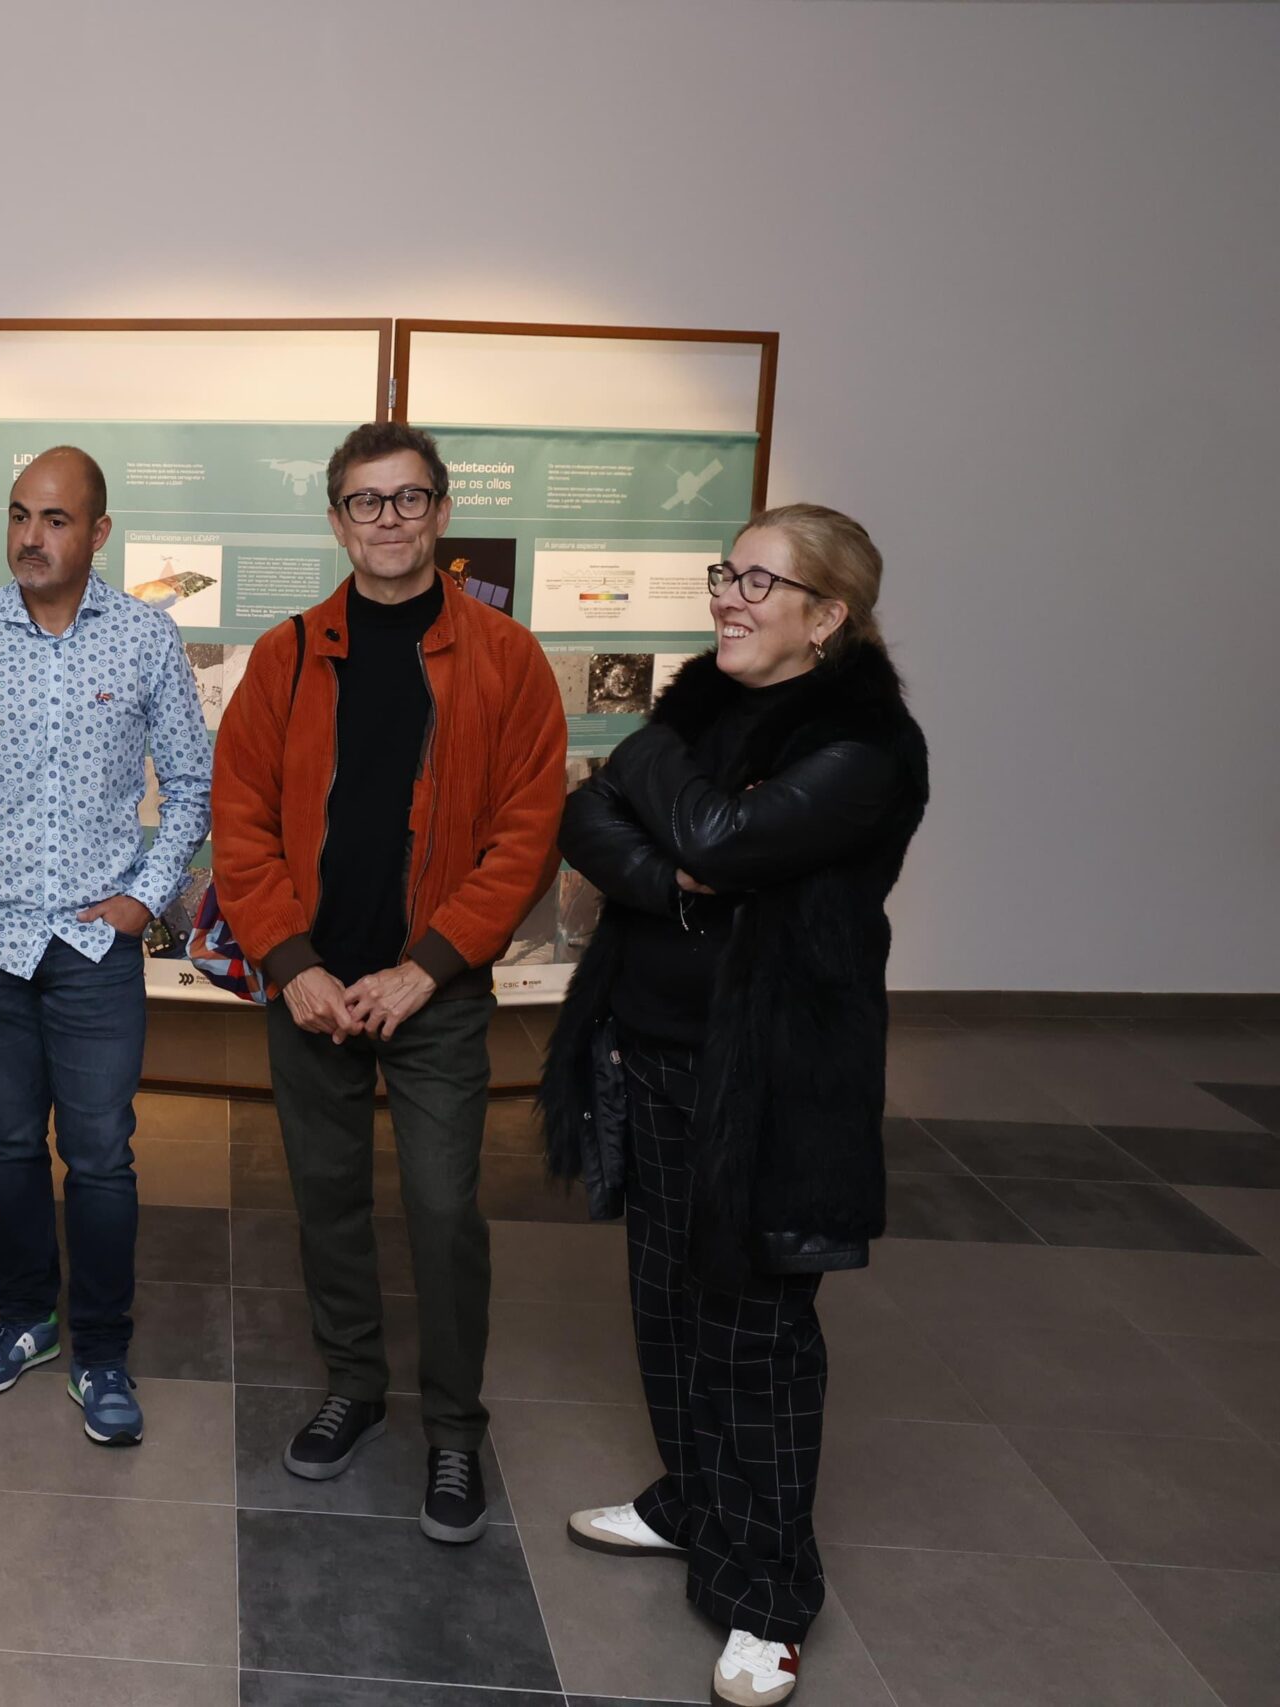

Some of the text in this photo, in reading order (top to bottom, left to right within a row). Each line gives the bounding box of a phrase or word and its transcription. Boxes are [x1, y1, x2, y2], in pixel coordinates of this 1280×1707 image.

[14, 454, 40, 465] LiD
[469, 480, 483, 489] os
[486, 478, 511, 490] ollos
[457, 494, 513, 507] poden ver
